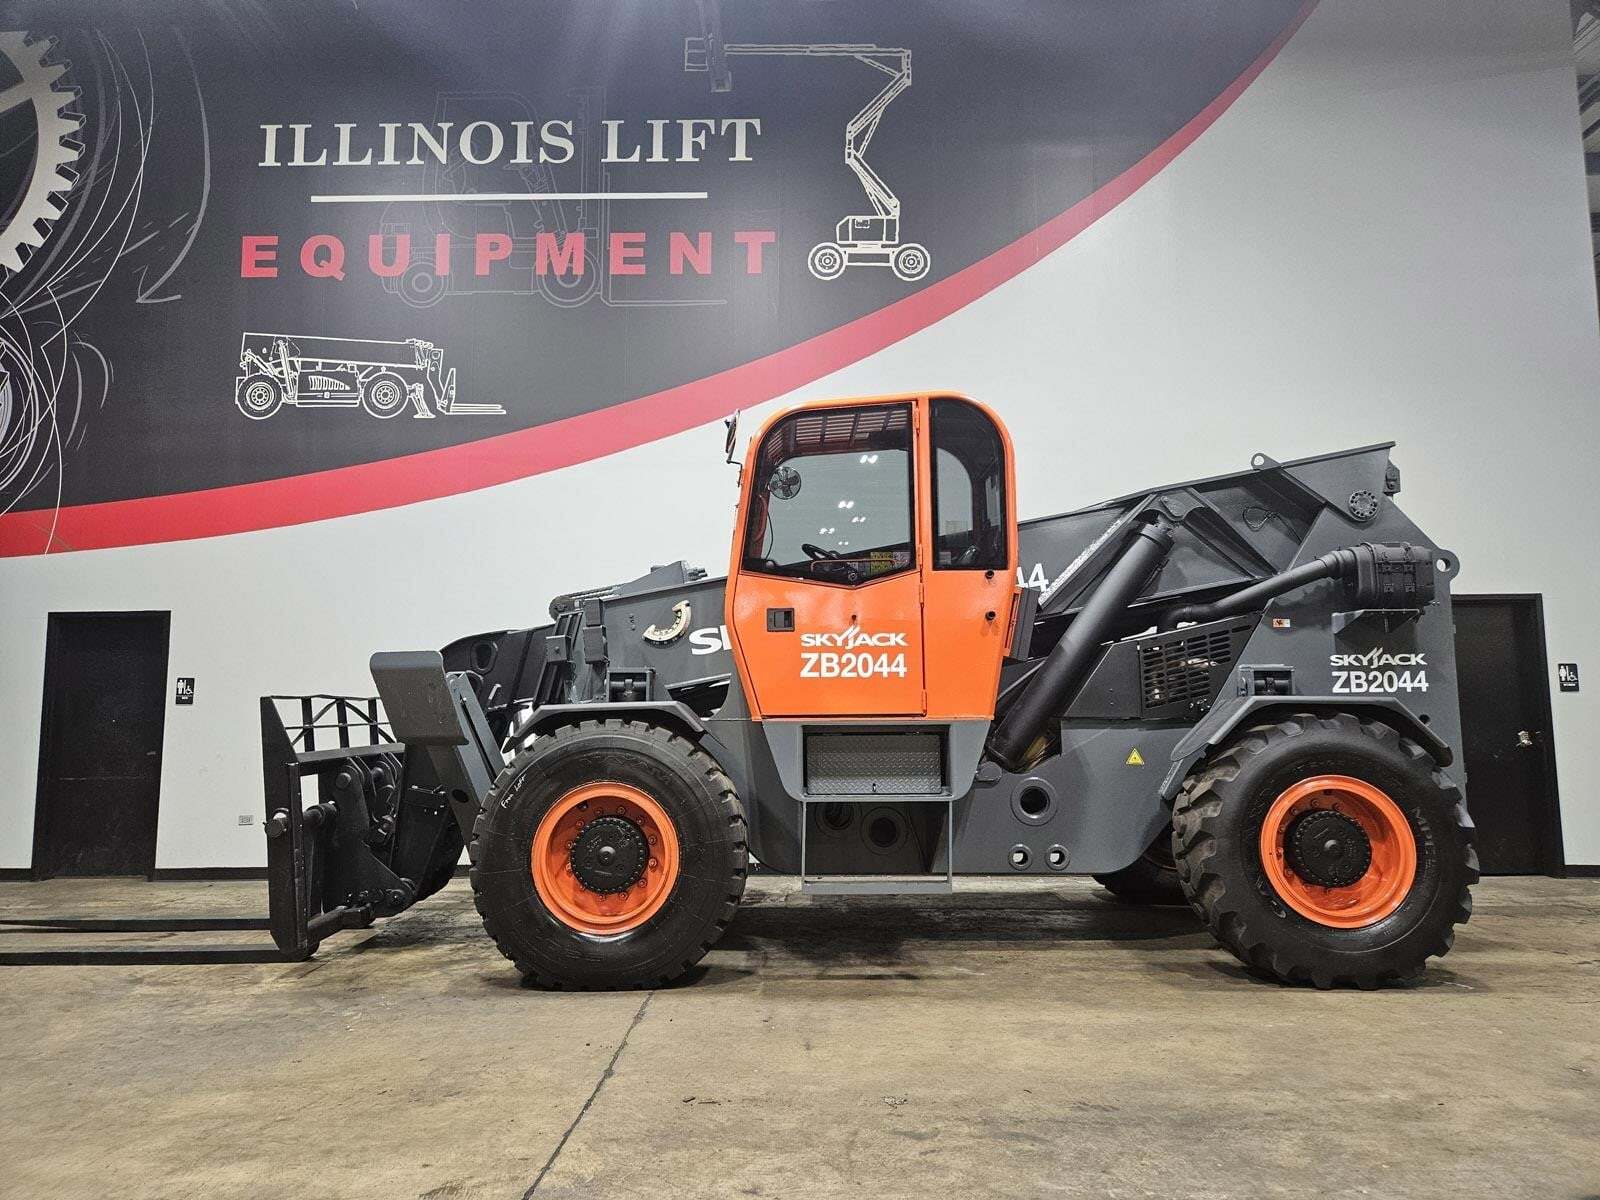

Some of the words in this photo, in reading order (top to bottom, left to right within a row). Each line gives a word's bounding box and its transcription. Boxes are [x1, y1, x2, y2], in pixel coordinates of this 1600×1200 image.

[258, 120, 575, 167] ILLINOIS
[601, 118, 762, 163] LIFT
[240, 230, 776, 281] EQUIPMENT
[800, 624, 909, 650] SKYJACK
[800, 652, 908, 678] ZB2044
[1329, 647, 1428, 669] SKYJACK
[1331, 670, 1430, 693] ZB2044
